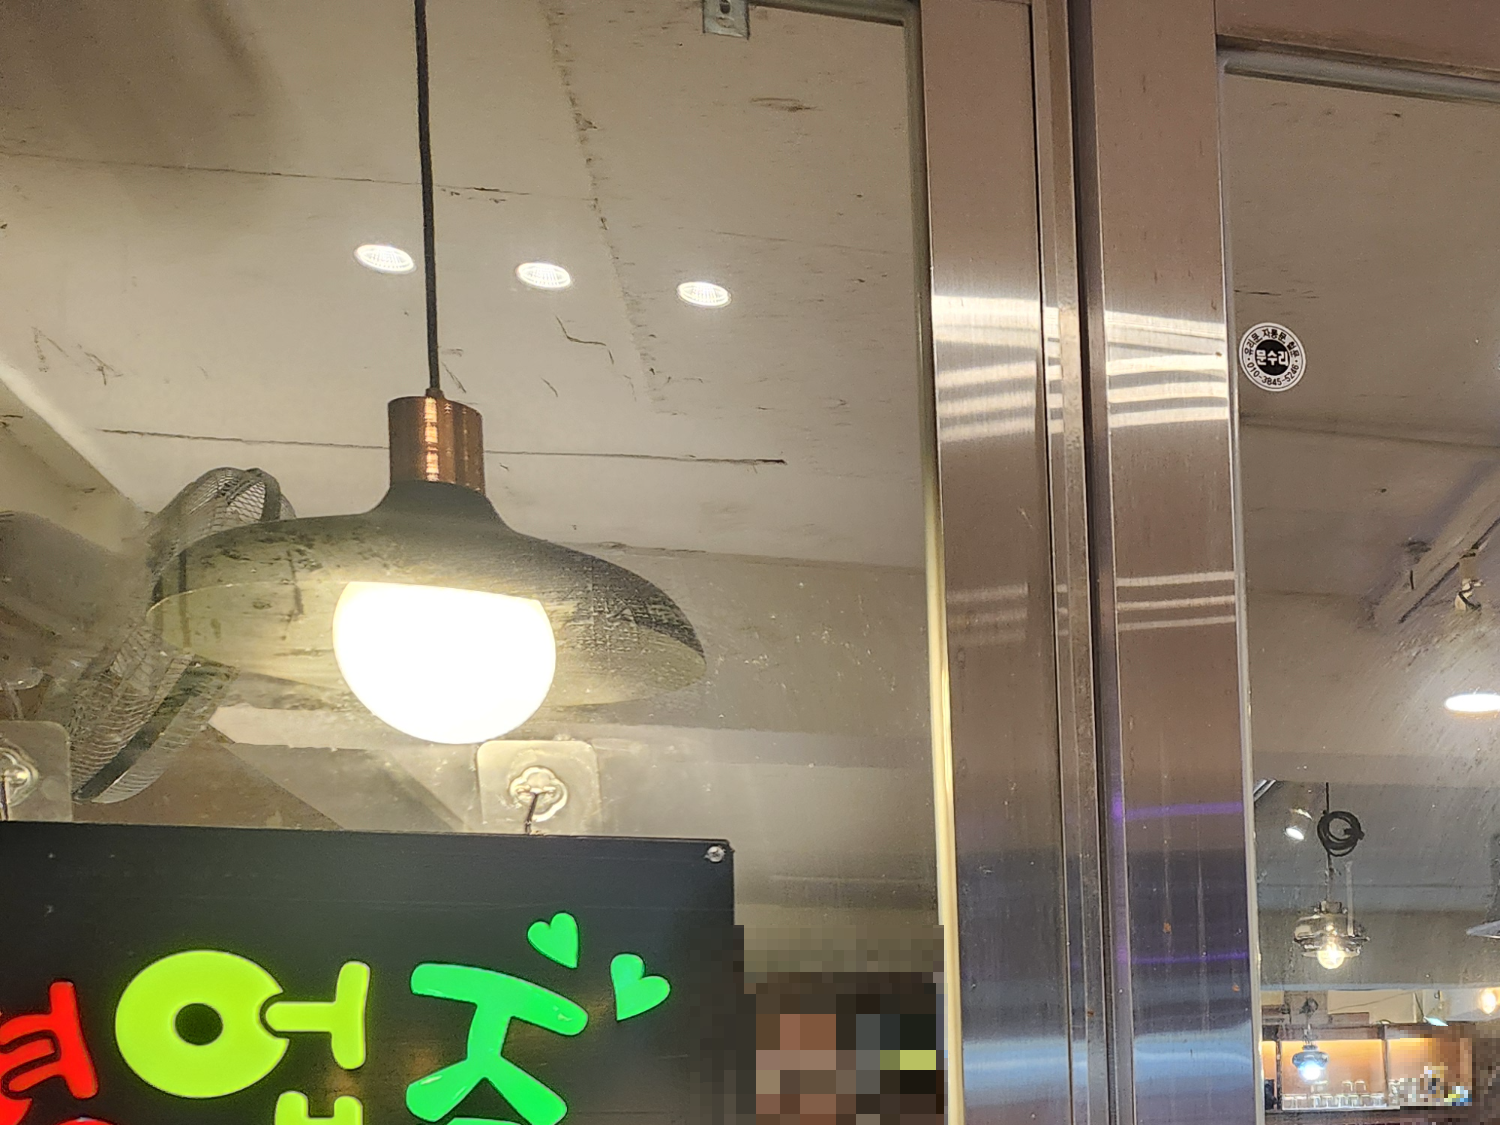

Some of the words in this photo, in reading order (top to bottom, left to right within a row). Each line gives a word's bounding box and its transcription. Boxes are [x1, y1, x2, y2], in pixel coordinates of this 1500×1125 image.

[1245, 333, 1262, 355] 유리문
[1262, 329, 1286, 344] 자동문
[1256, 350, 1288, 366] 문수리
[1247, 362, 1299, 386] 010-3845-5246
